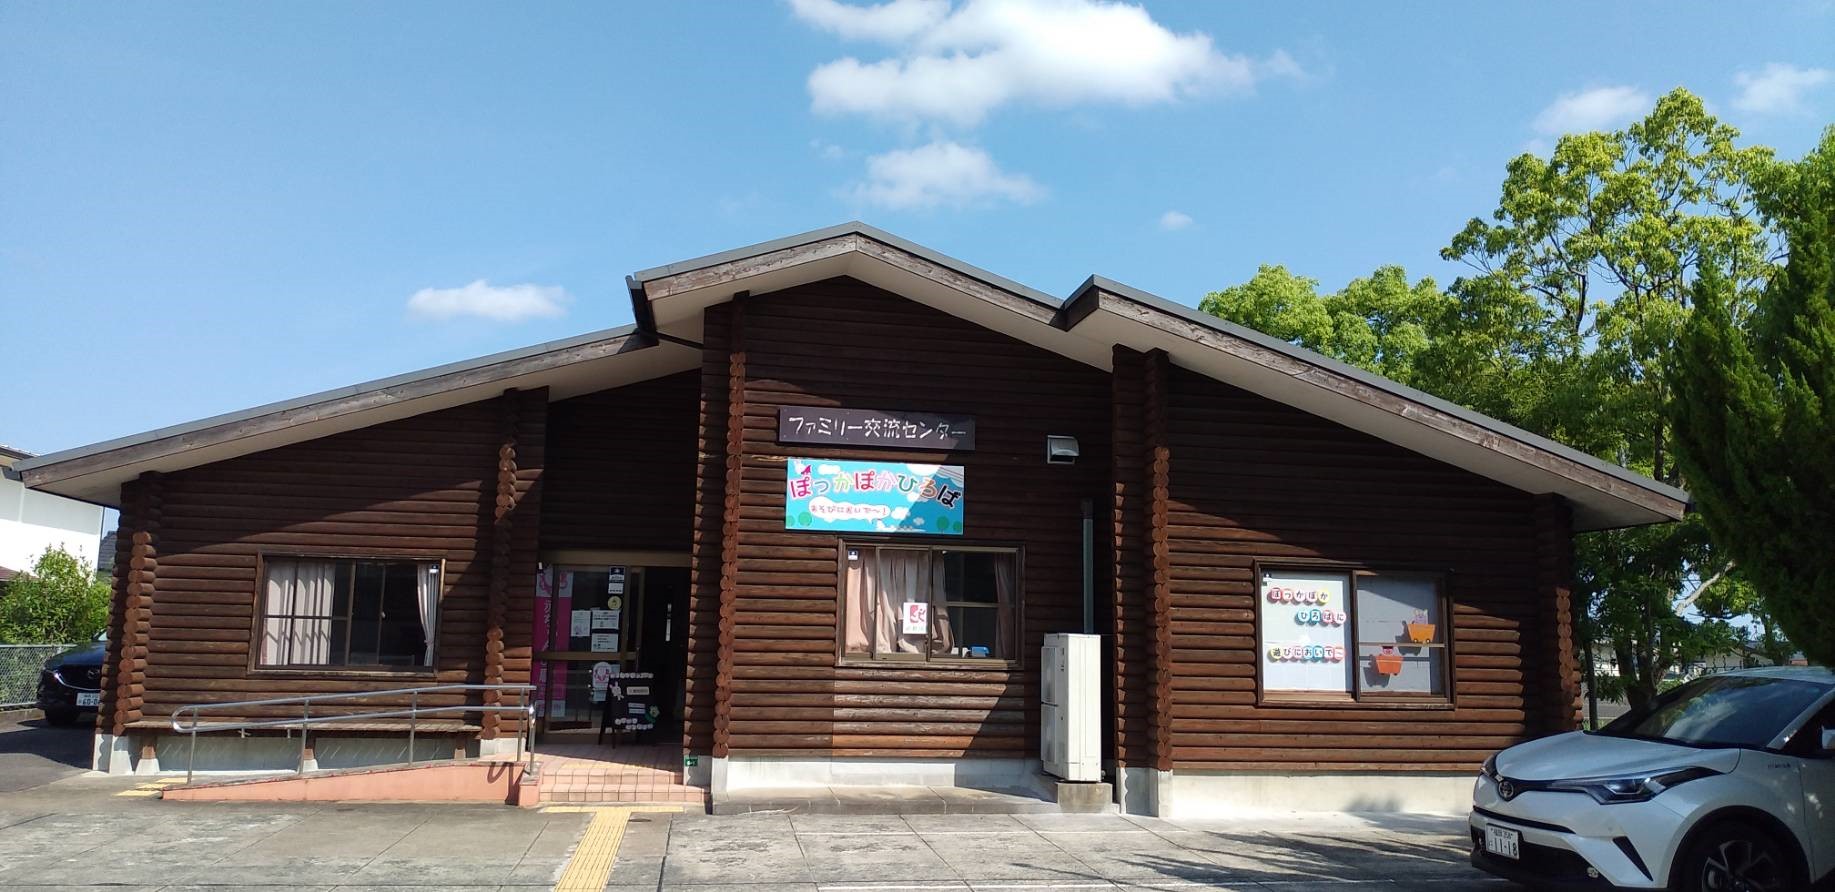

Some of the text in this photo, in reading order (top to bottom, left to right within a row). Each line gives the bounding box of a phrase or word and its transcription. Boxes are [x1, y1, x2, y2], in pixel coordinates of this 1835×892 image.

[788, 416, 967, 440] ファミリー交流センター
[789, 471, 962, 508] ぽっかぽかひろば
